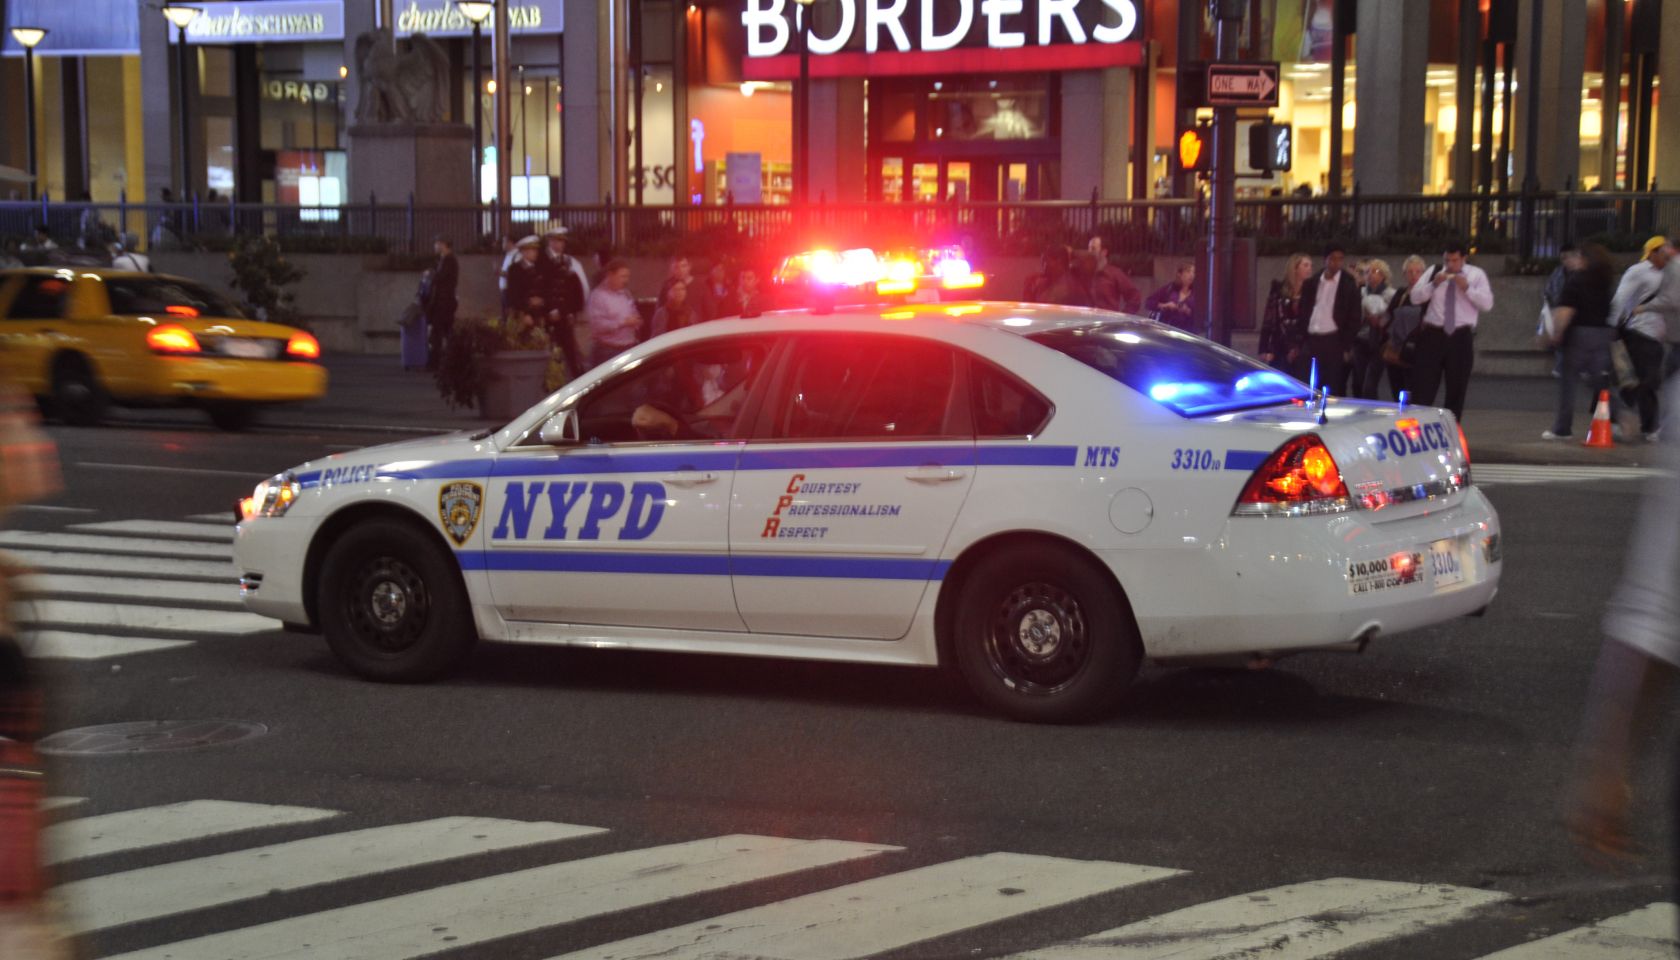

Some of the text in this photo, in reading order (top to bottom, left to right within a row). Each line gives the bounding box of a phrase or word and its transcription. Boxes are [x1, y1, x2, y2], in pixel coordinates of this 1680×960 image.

[742, 0, 1136, 57] BORDERS
[1214, 77, 1266, 90] ONE WAY
[1368, 422, 1449, 461] POLICE
[1084, 446, 1120, 467] MTS
[321, 463, 375, 486] POLICE
[786, 474, 861, 494] COURTESY
[491, 481, 667, 540] NYPD
[773, 495, 902, 516] PROFESSIONALISM
[761, 518, 828, 538] RESPECT
[1349, 559, 1388, 578] $10,000
